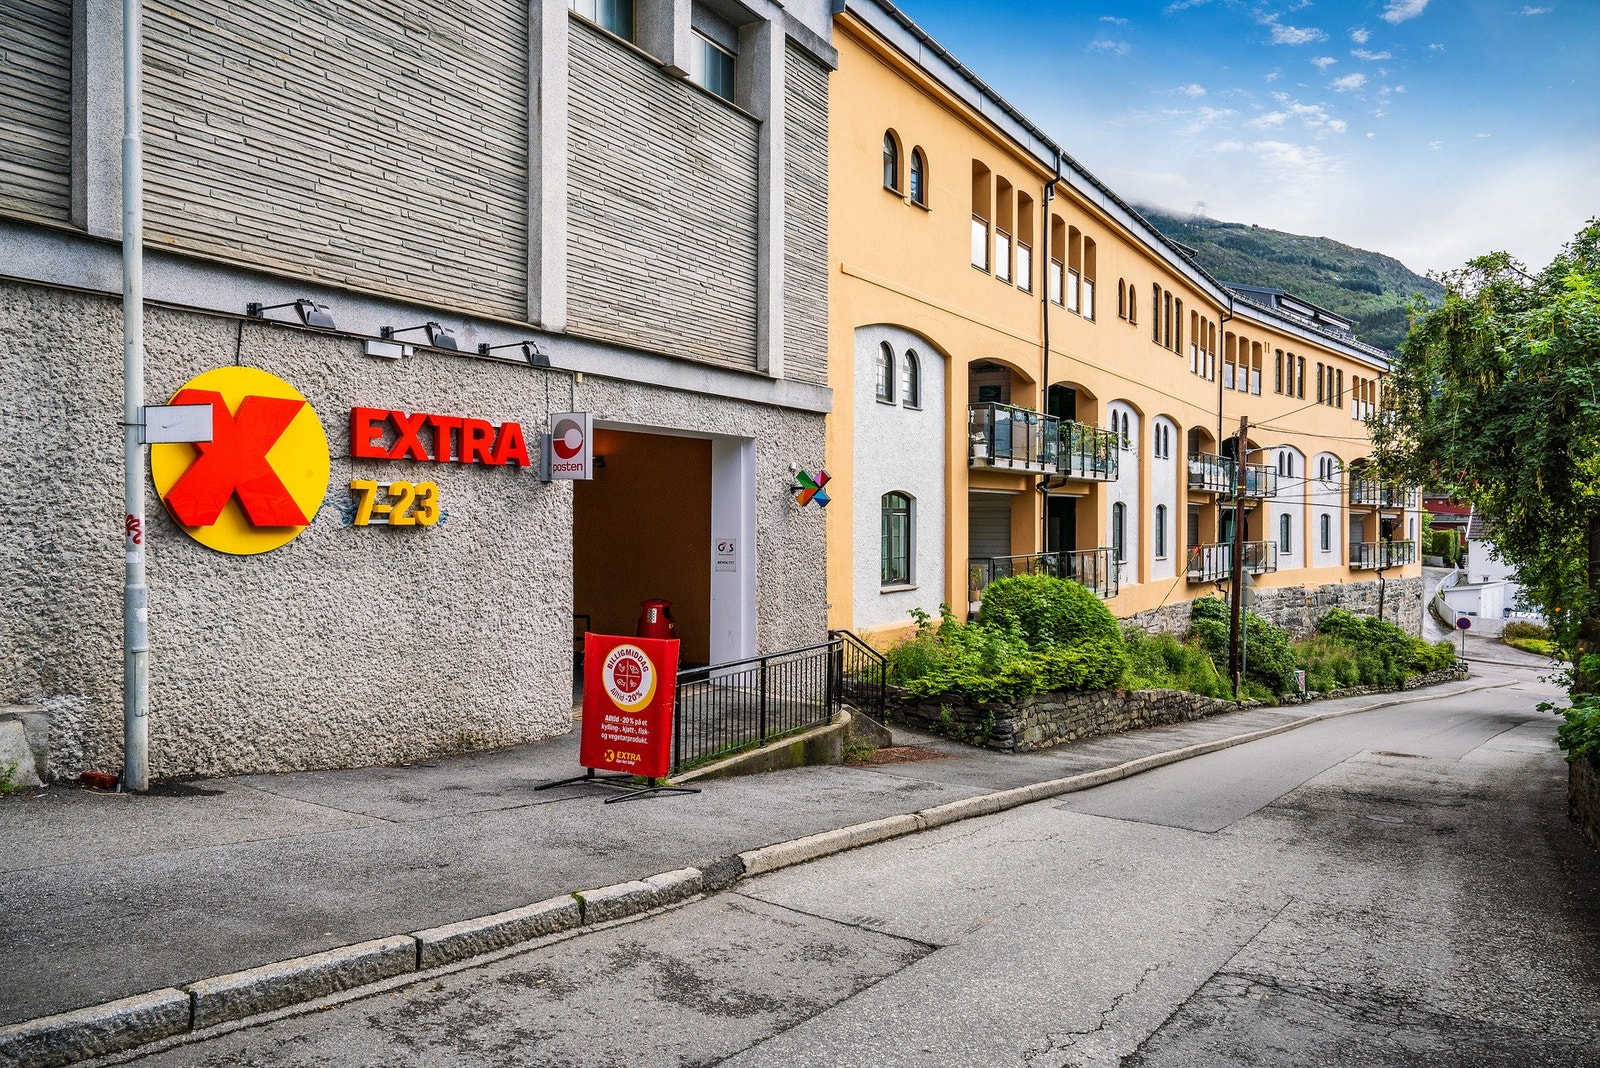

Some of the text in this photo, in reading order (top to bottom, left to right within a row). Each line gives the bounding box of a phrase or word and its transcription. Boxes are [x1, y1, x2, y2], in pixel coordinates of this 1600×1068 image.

[351, 406, 531, 467] EXTRA
[552, 461, 583, 474] posten
[350, 480, 440, 526] 7-23
[718, 542, 734, 552] GS
[607, 649, 649, 672] BILLIGMIDDAG
[610, 688, 642, 702] Alltid -20%
[634, 718, 641, 726] på
[601, 732, 608, 740] og
[616, 751, 641, 761] EXTRA
